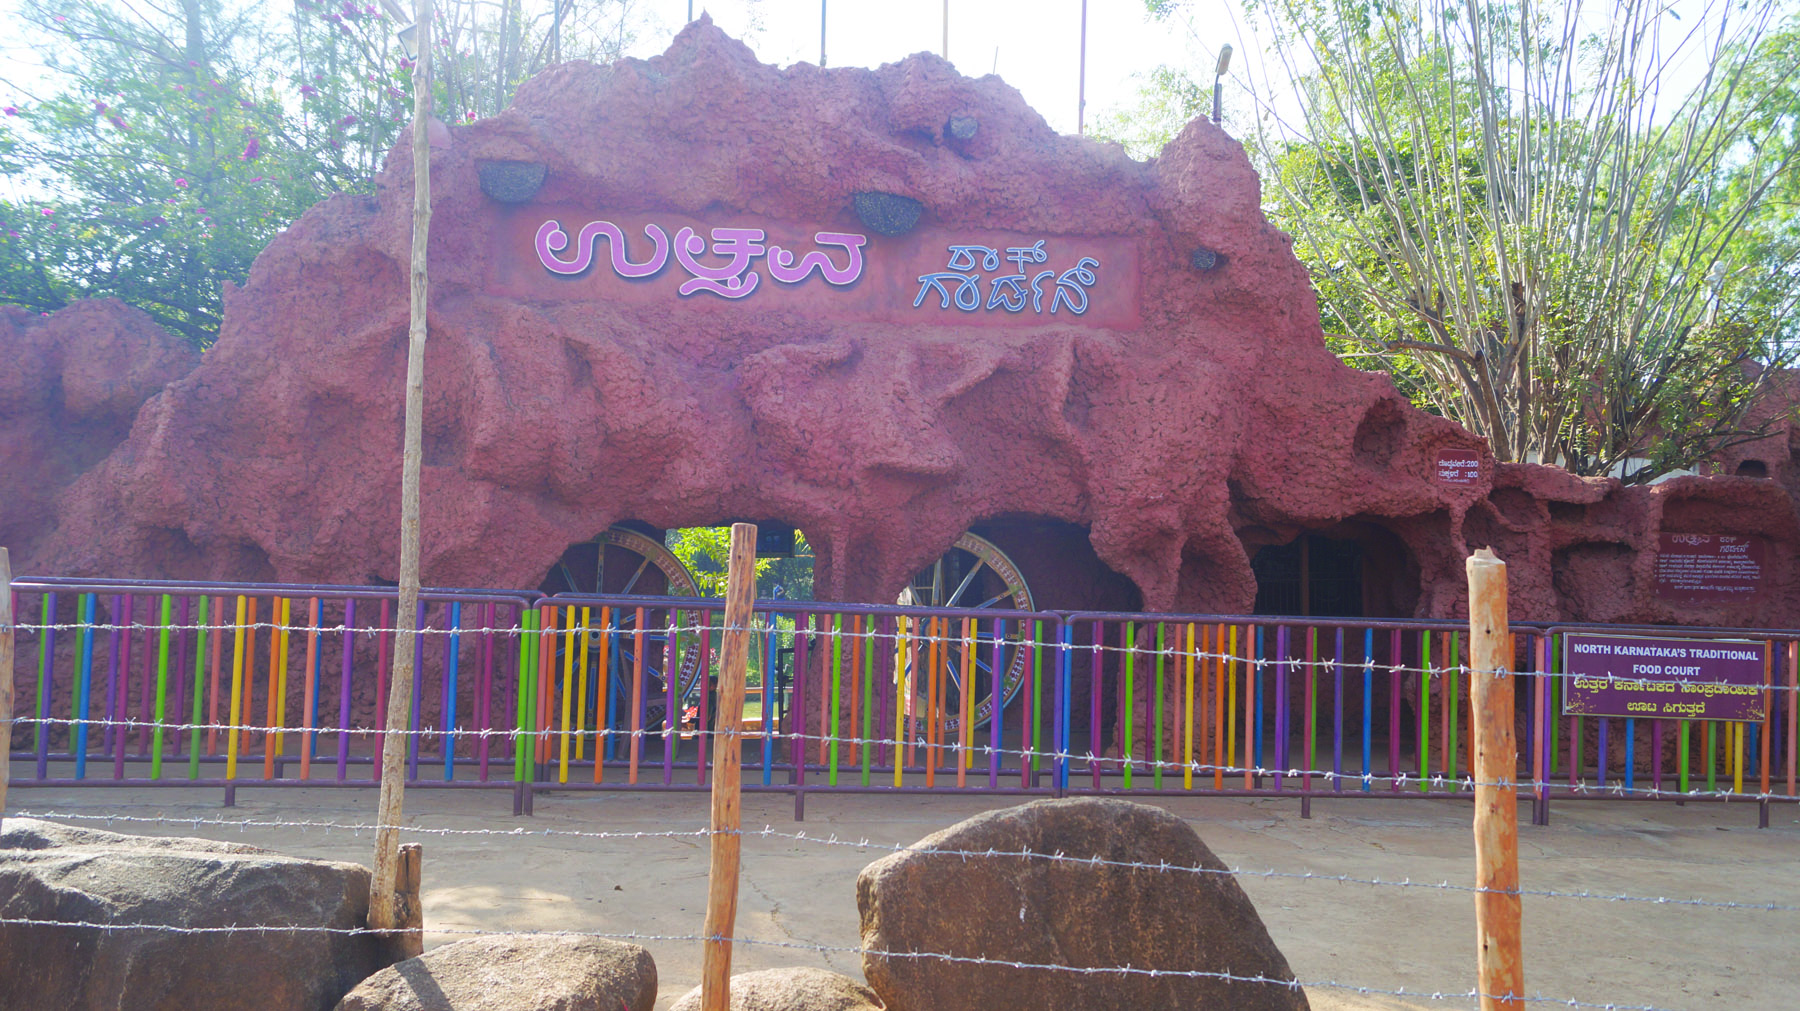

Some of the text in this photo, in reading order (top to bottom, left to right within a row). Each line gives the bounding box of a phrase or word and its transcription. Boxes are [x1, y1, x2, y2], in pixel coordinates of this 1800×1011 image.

[1574, 643, 1759, 661] NORTH KARNATAKA'S TRADITIONAL
[1632, 664, 1701, 676] FOOD COURT
[1574, 678, 1608, 694] ಉತ್ತರ
[1614, 680, 1675, 693] ಕರ್ನಾಟಕದ
[1627, 701, 1706, 718] ಊಟ ಸಿಗುತ್ತದೆ
